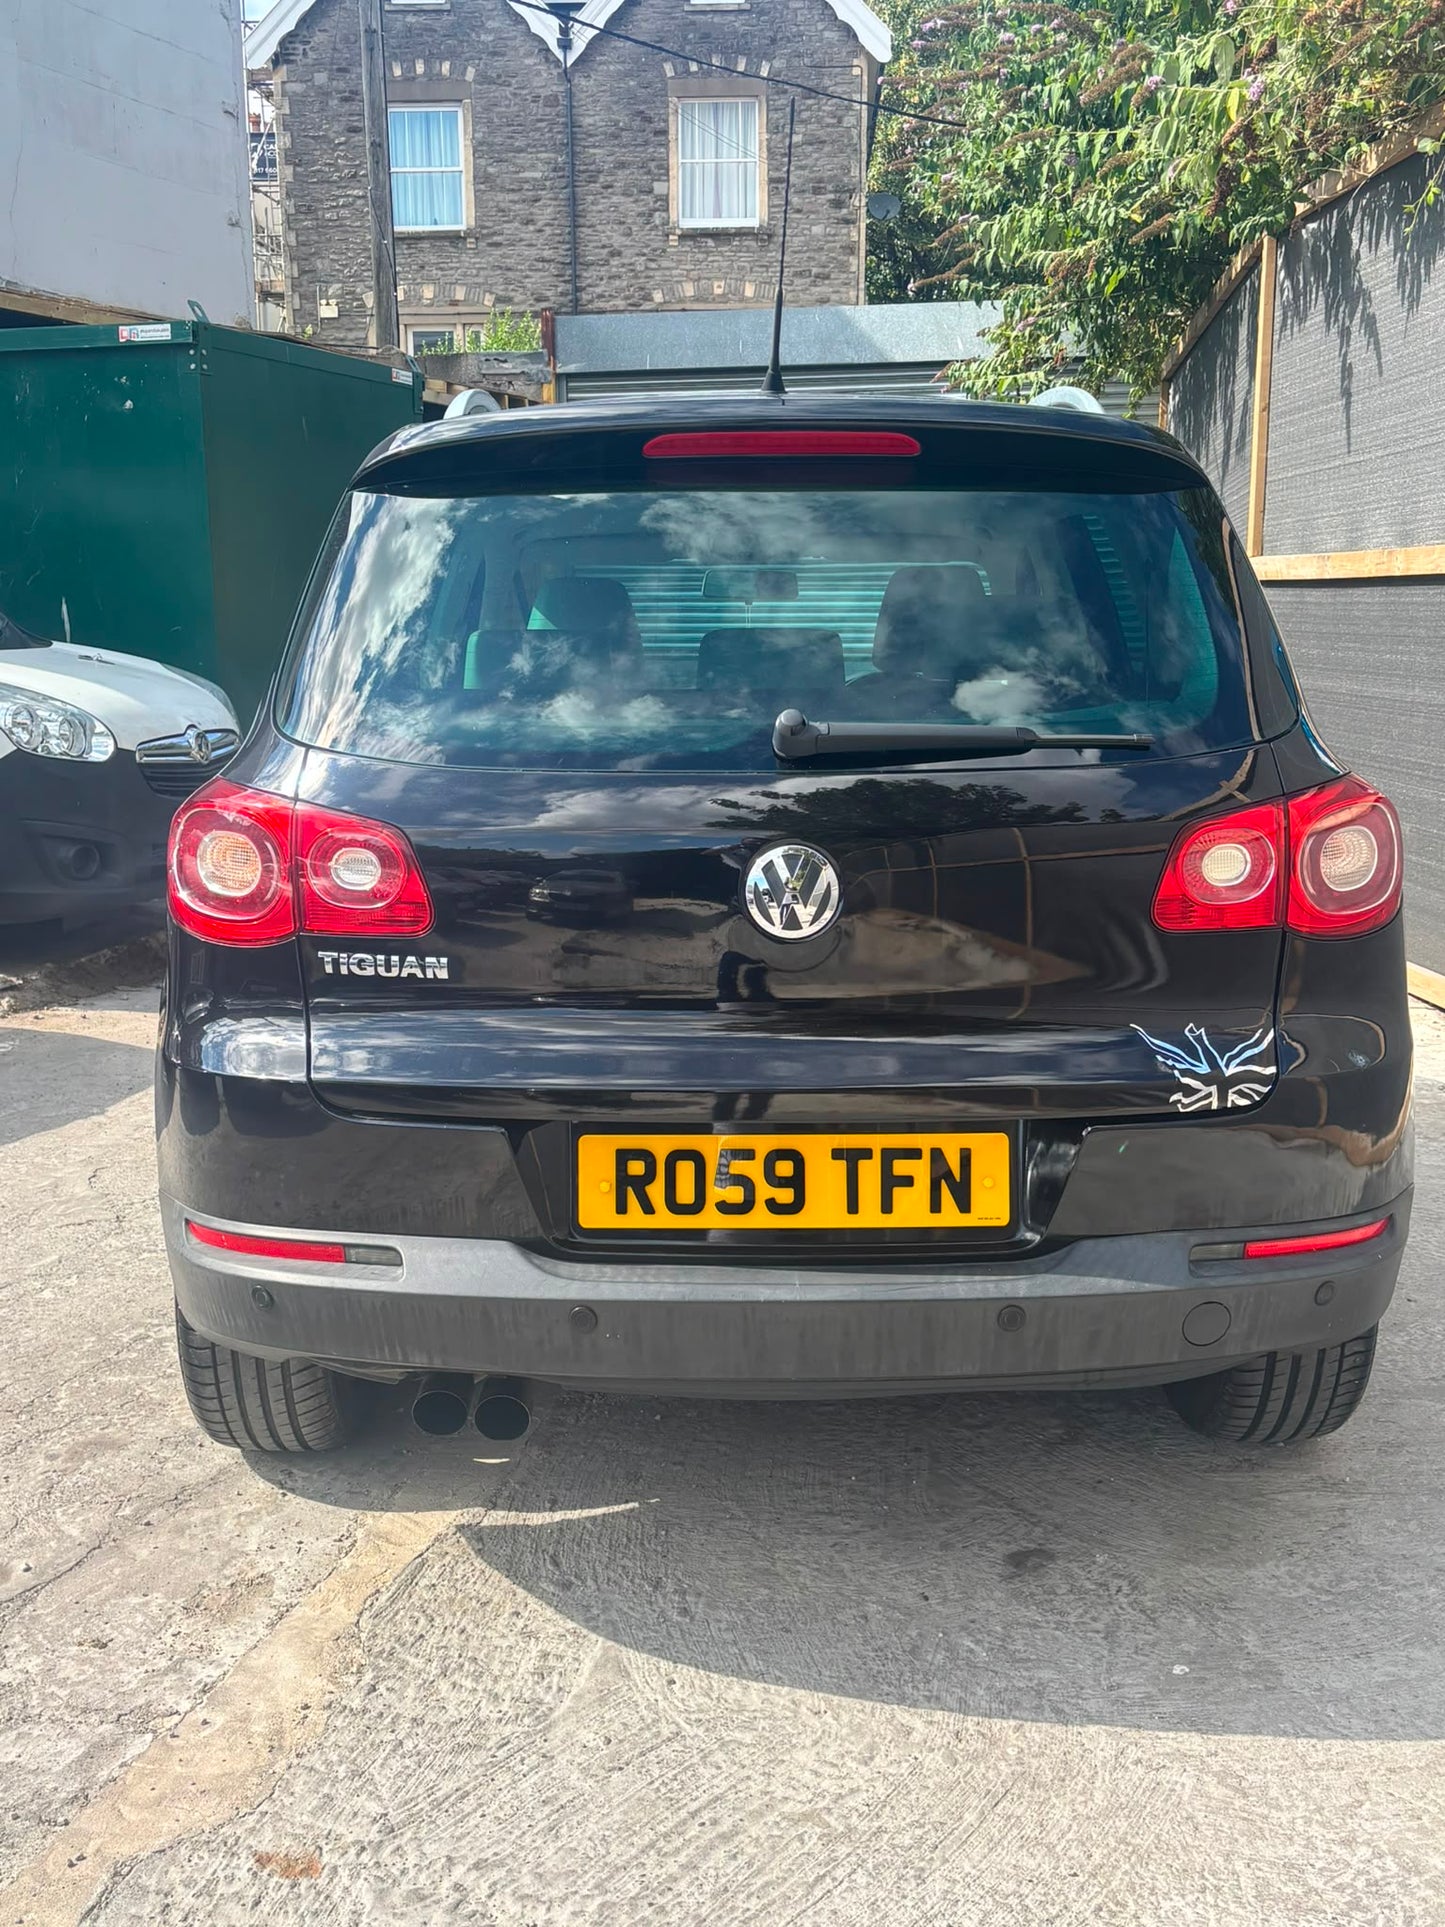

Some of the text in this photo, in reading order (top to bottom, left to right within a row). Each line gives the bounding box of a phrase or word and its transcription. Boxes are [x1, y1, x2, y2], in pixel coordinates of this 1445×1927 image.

[318, 951, 449, 979] TIGUAN
[615, 1147, 972, 1215] RO59 TFN
